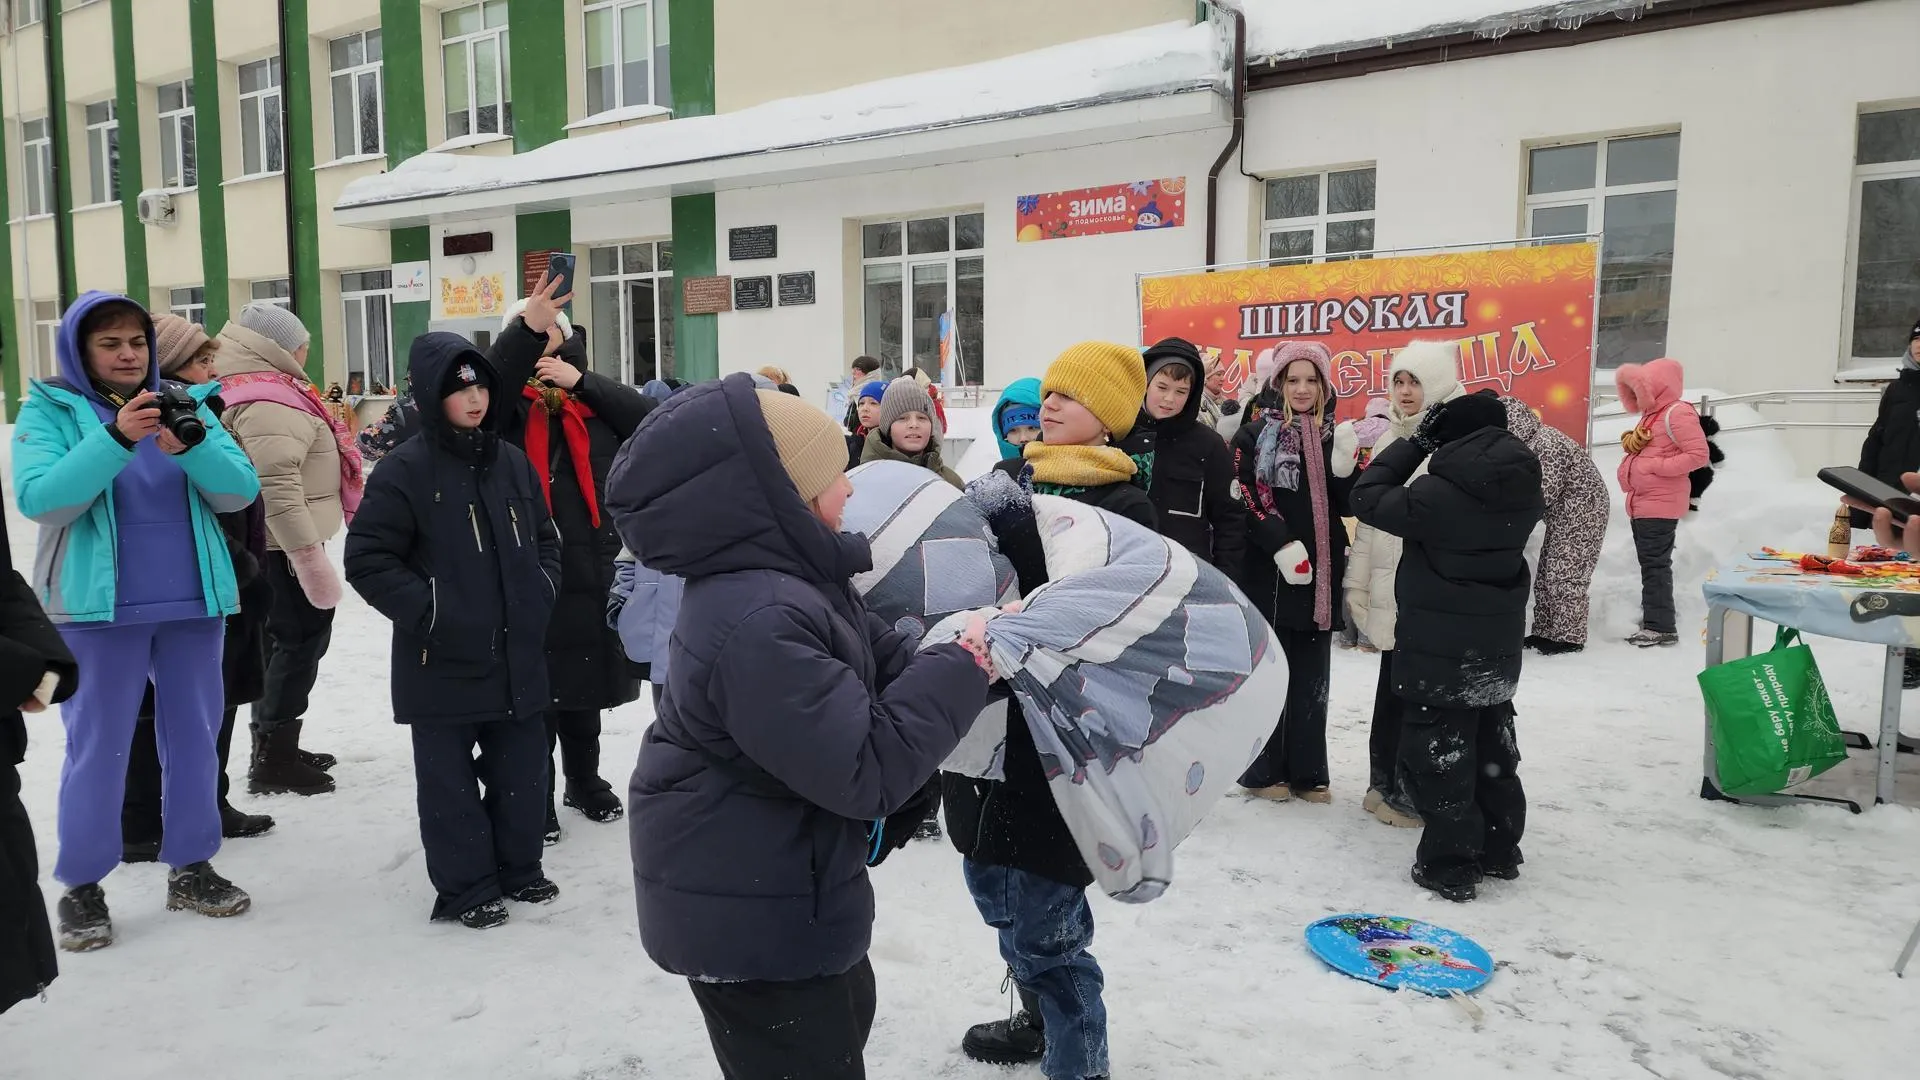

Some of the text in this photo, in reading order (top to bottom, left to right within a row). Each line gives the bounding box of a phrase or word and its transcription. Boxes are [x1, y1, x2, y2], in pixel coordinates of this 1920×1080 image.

[1240, 292, 1467, 338] ШИРОКАЯ
[1754, 677, 1774, 708] пакет
[1761, 663, 1790, 709] природу
[1768, 710, 1786, 737] беру
